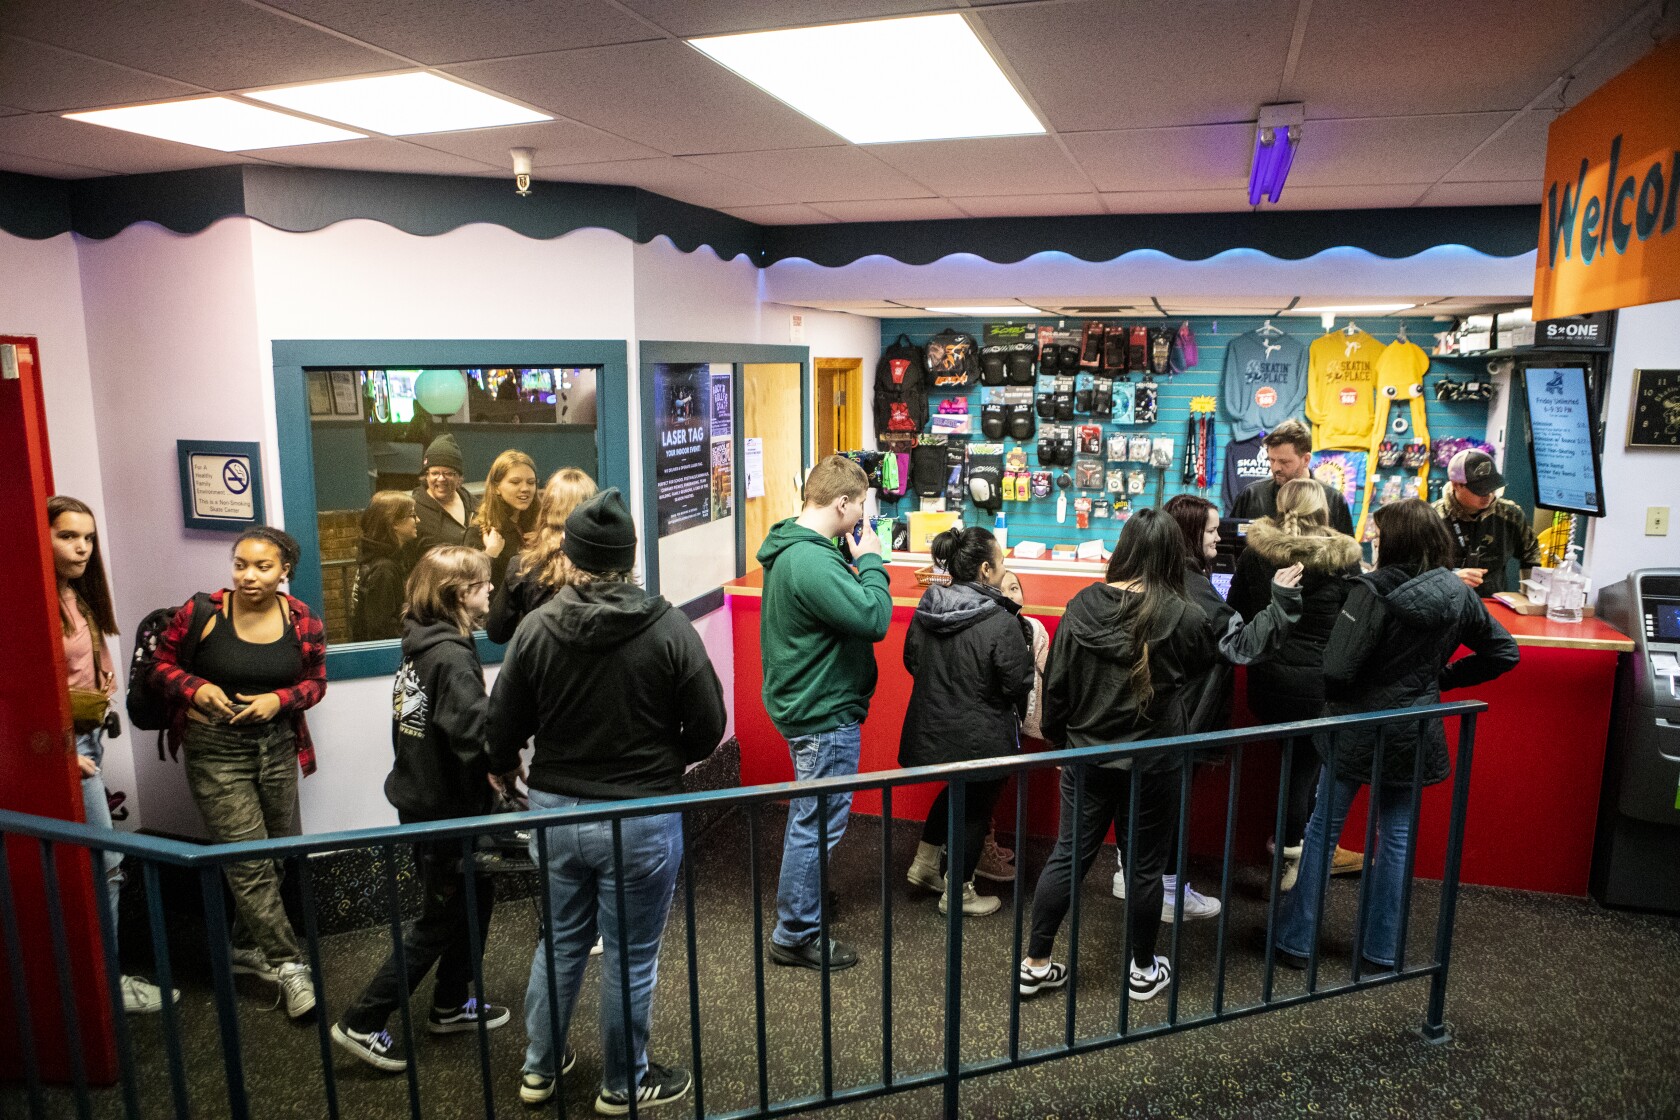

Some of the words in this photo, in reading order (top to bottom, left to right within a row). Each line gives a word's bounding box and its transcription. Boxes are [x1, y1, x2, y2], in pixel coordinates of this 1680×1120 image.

[1548, 133, 1680, 270] Welco
[1263, 372, 1288, 384] PLACE
[1344, 371, 1371, 382] PLACE
[1658, 378, 1667, 386] 11
[1536, 397, 1552, 405] Friday
[662, 430, 687, 447] LASER
[688, 426, 704, 442] TAG
[1653, 431, 1660, 439] 7
[1670, 436, 1677, 444] 6
[666, 449, 676, 457] YOUR
[676, 447, 690, 456] INDOOR
[1237, 467, 1269, 475] PLACE
[219, 499, 251, 508] Non-Smoking
